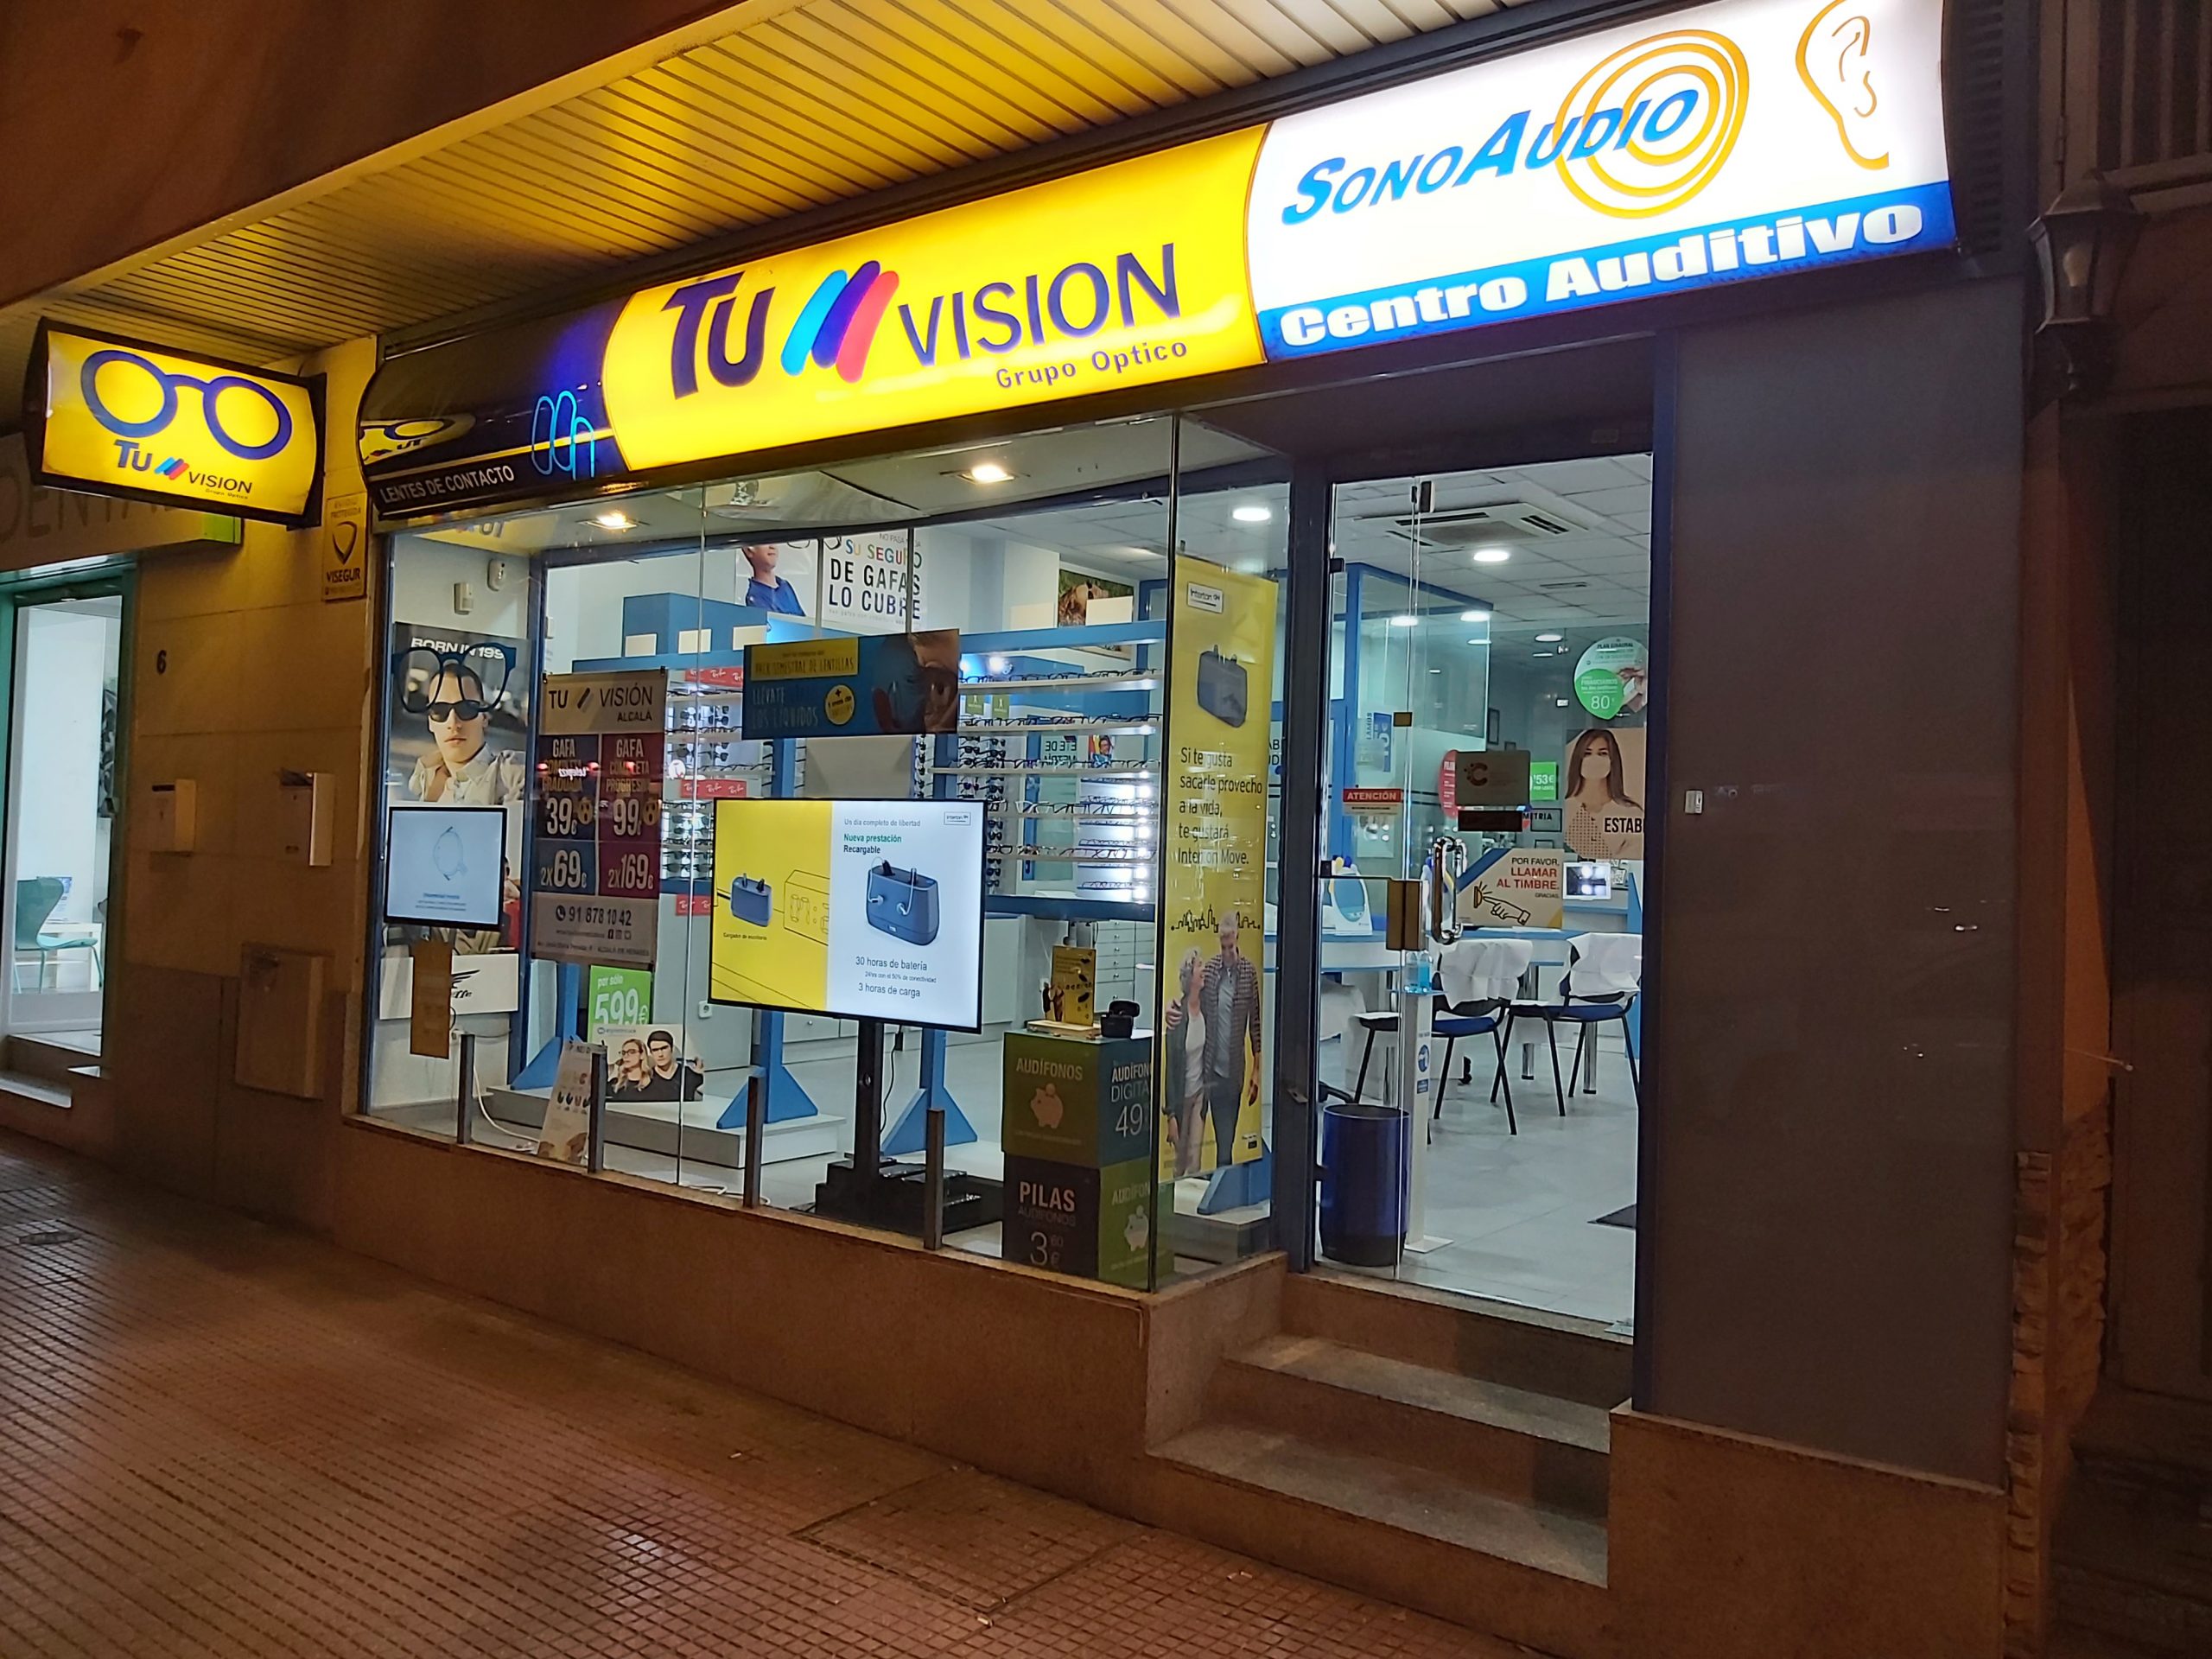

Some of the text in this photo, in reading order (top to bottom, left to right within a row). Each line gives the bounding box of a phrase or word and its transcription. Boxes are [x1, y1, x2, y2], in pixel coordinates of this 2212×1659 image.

[1281, 202, 1922, 347] Centro Auditivo
[899, 243, 1181, 368] VISION
[996, 340, 1187, 389] Grupo Optico
[188, 472, 252, 493] VISION
[379, 465, 515, 504] LENTES DE CONTACTO
[845, 538, 861, 556] SU
[327, 568, 360, 584] VISEGUR
[830, 557, 920, 596] DE GAFAS
[829, 583, 852, 608] LO
[861, 589, 920, 620] CUBRE
[156, 649, 167, 674] 6
[548, 683, 653, 709] TU VISIÓN
[1591, 695, 1611, 709] 80
[553, 738, 575, 759] GAFA
[616, 738, 644, 759] GAFA
[1180, 747, 1233, 769] Si te gusta
[1179, 774, 1262, 794] sacarle provecho
[1347, 791, 1396, 801] ATENCIÓN
[1179, 802, 1185, 813] a
[863, 819, 889, 828] completo
[899, 819, 921, 828] libertad
[1179, 823, 1190, 839] te
[1604, 817, 1643, 833] ESTAB
[843, 833, 902, 844] Nueva prestación
[843, 844, 881, 855] Recargable
[1221, 849, 1249, 865] Move.
[1510, 867, 1557, 878] LLAMAR
[1497, 878, 1560, 890] AL TIMBRE.
[569, 906, 632, 926] 91 878 10 42
[855, 957, 927, 971] 30 horas de batería
[597, 977, 608, 989] por
[858, 982, 920, 999] 3 horas de carga
[1016, 1056, 1084, 1081] AUDÍFONOS
[1111, 1061, 1151, 1084] AUDÍFON
[1111, 1080, 1150, 1103] DIGITA
[1020, 1181, 1076, 1212] PILAS
[1111, 1182, 1150, 1206] AUDÍFON
[1030, 1231, 1048, 1267] 3
